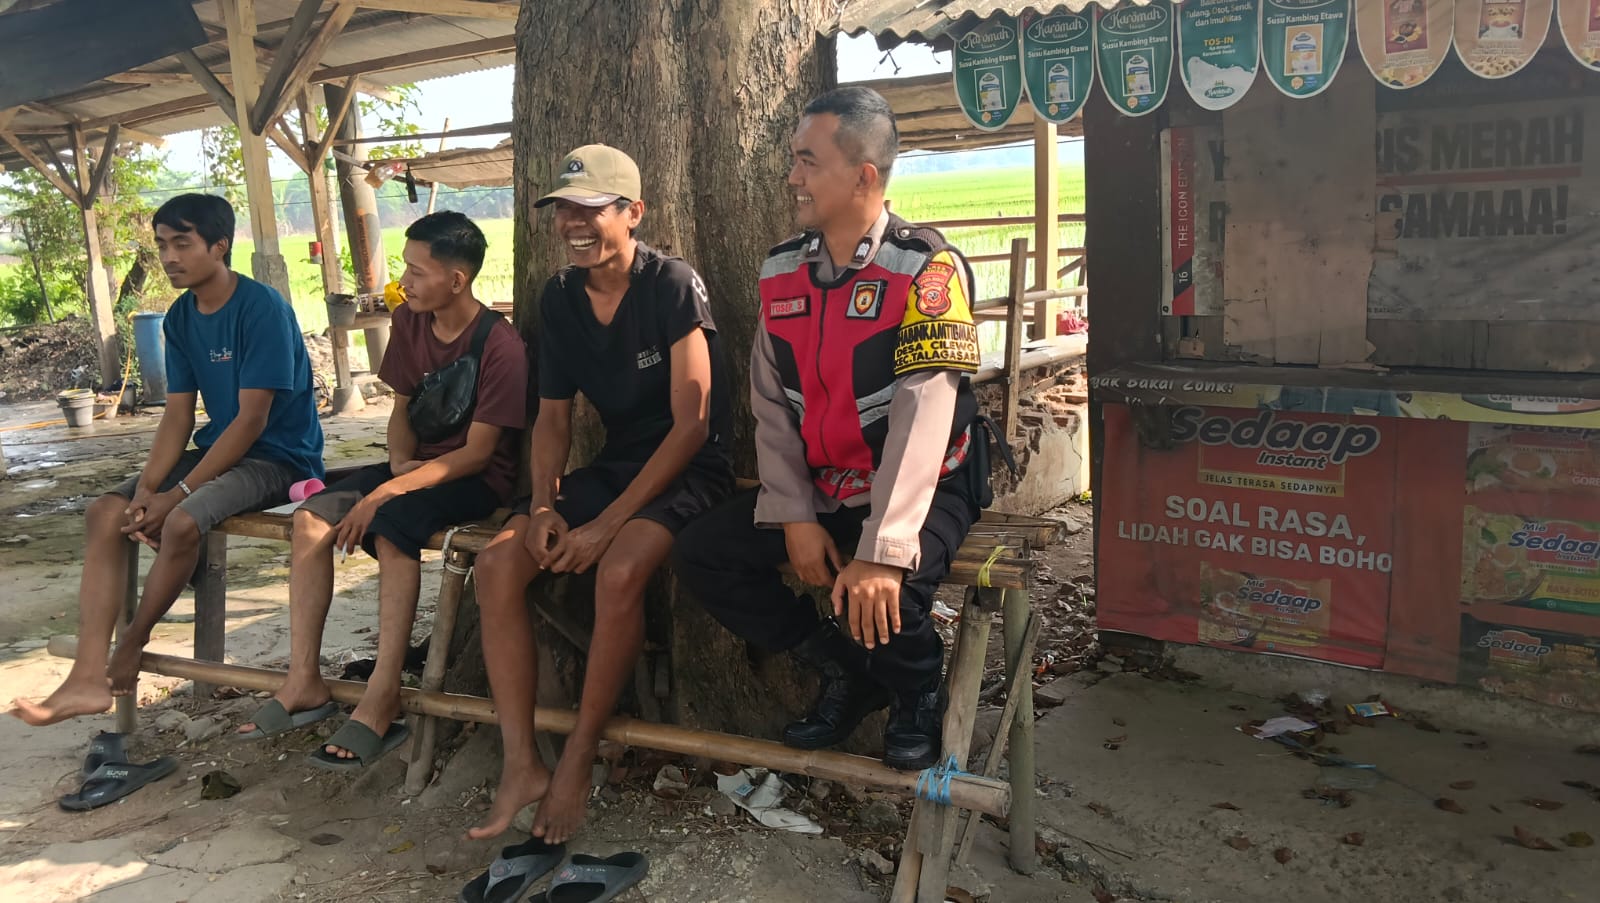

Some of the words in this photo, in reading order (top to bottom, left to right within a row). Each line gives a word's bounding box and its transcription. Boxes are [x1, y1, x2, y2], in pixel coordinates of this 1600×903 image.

[1195, 18, 1209, 26] dan
[1267, 17, 1285, 25] Susu
[1286, 13, 1319, 23] Kambing
[1320, 12, 1343, 20] Etawa
[1119, 38, 1148, 47] Kambing
[1204, 36, 1233, 46] TOS-IN
[1043, 47, 1069, 56] Kambing
[973, 57, 998, 65] Kambing
[1431, 112, 1584, 171] MERAH
[1178, 191, 1188, 221] ICON
[1178, 224, 1188, 249] THE
[1179, 271, 1188, 284] 16
[896, 343, 923, 357] DESA
[930, 340, 975, 351] CILEWO
[1173, 407, 1380, 464] Sedaap
[1257, 452, 1329, 470] Instant
[1205, 474, 1233, 485] JELAS
[1238, 477, 1276, 489] TERASA
[1280, 481, 1337, 495] SEDAPNYA
[1166, 495, 1250, 527] SOAL
[1258, 505, 1367, 546] RASA,
[1522, 522, 1546, 533] Mie
[1118, 521, 1189, 546] LIDAH
[1195, 530, 1245, 553] GAK
[1252, 538, 1313, 563] BISA
[1246, 579, 1265, 589] Mie
[1236, 587, 1322, 612] Sedaap
[1479, 635, 1552, 657] Sedaap
